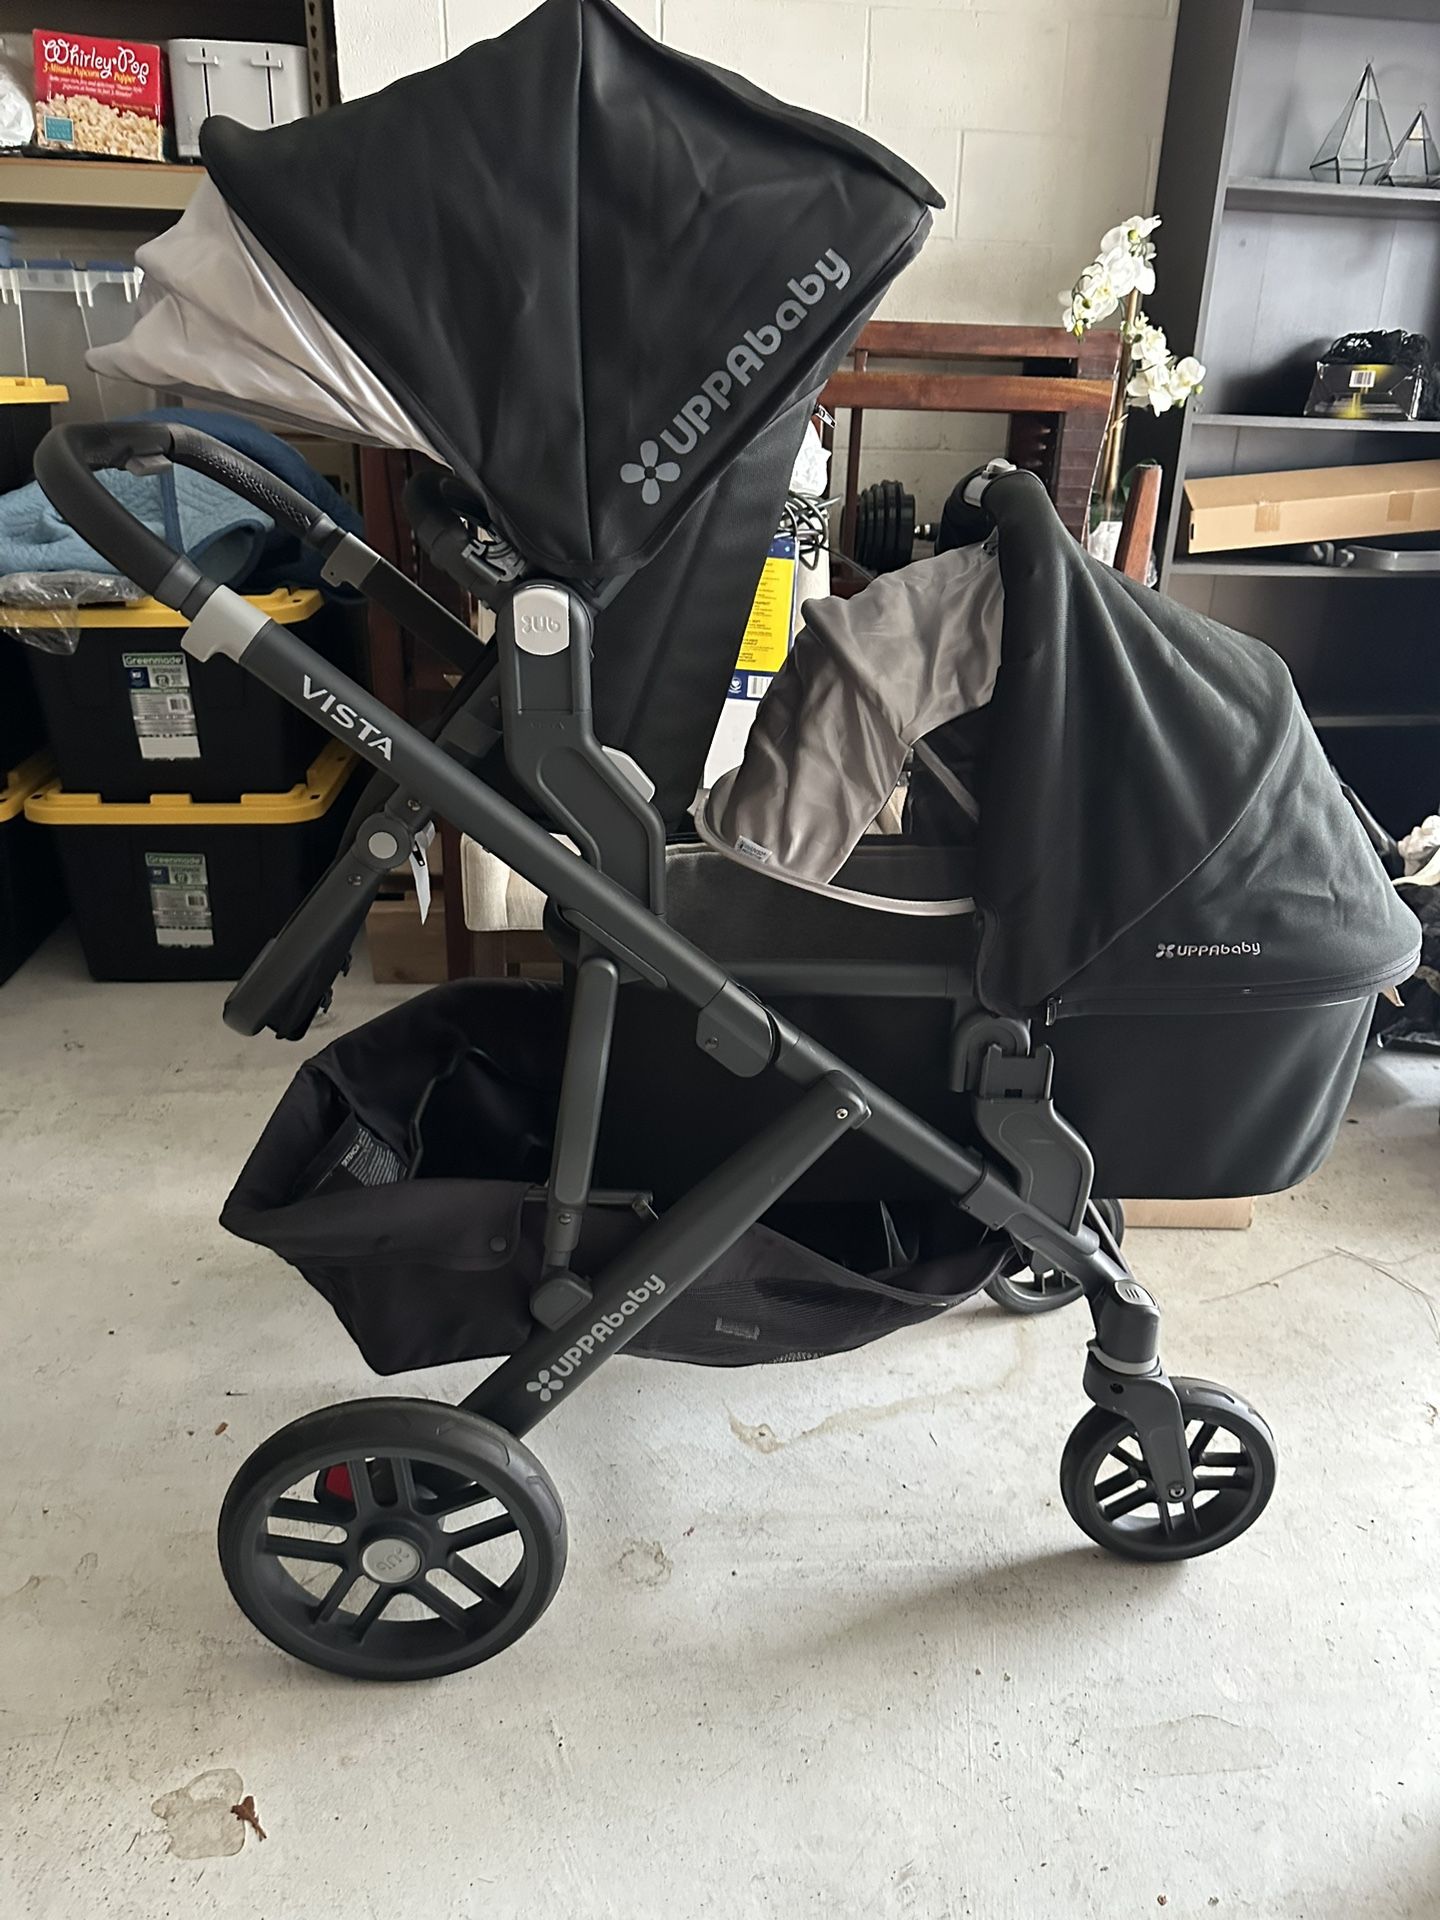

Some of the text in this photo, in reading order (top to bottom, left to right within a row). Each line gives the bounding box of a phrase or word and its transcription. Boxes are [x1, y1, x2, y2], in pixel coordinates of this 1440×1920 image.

[660, 248, 851, 455] UPPAbaby
[125, 656, 182, 666] Greenmade
[302, 674, 393, 762] VISTA
[1177, 941, 1261, 957] UPPAbaby
[551, 1274, 666, 1377] UPPAbaby
